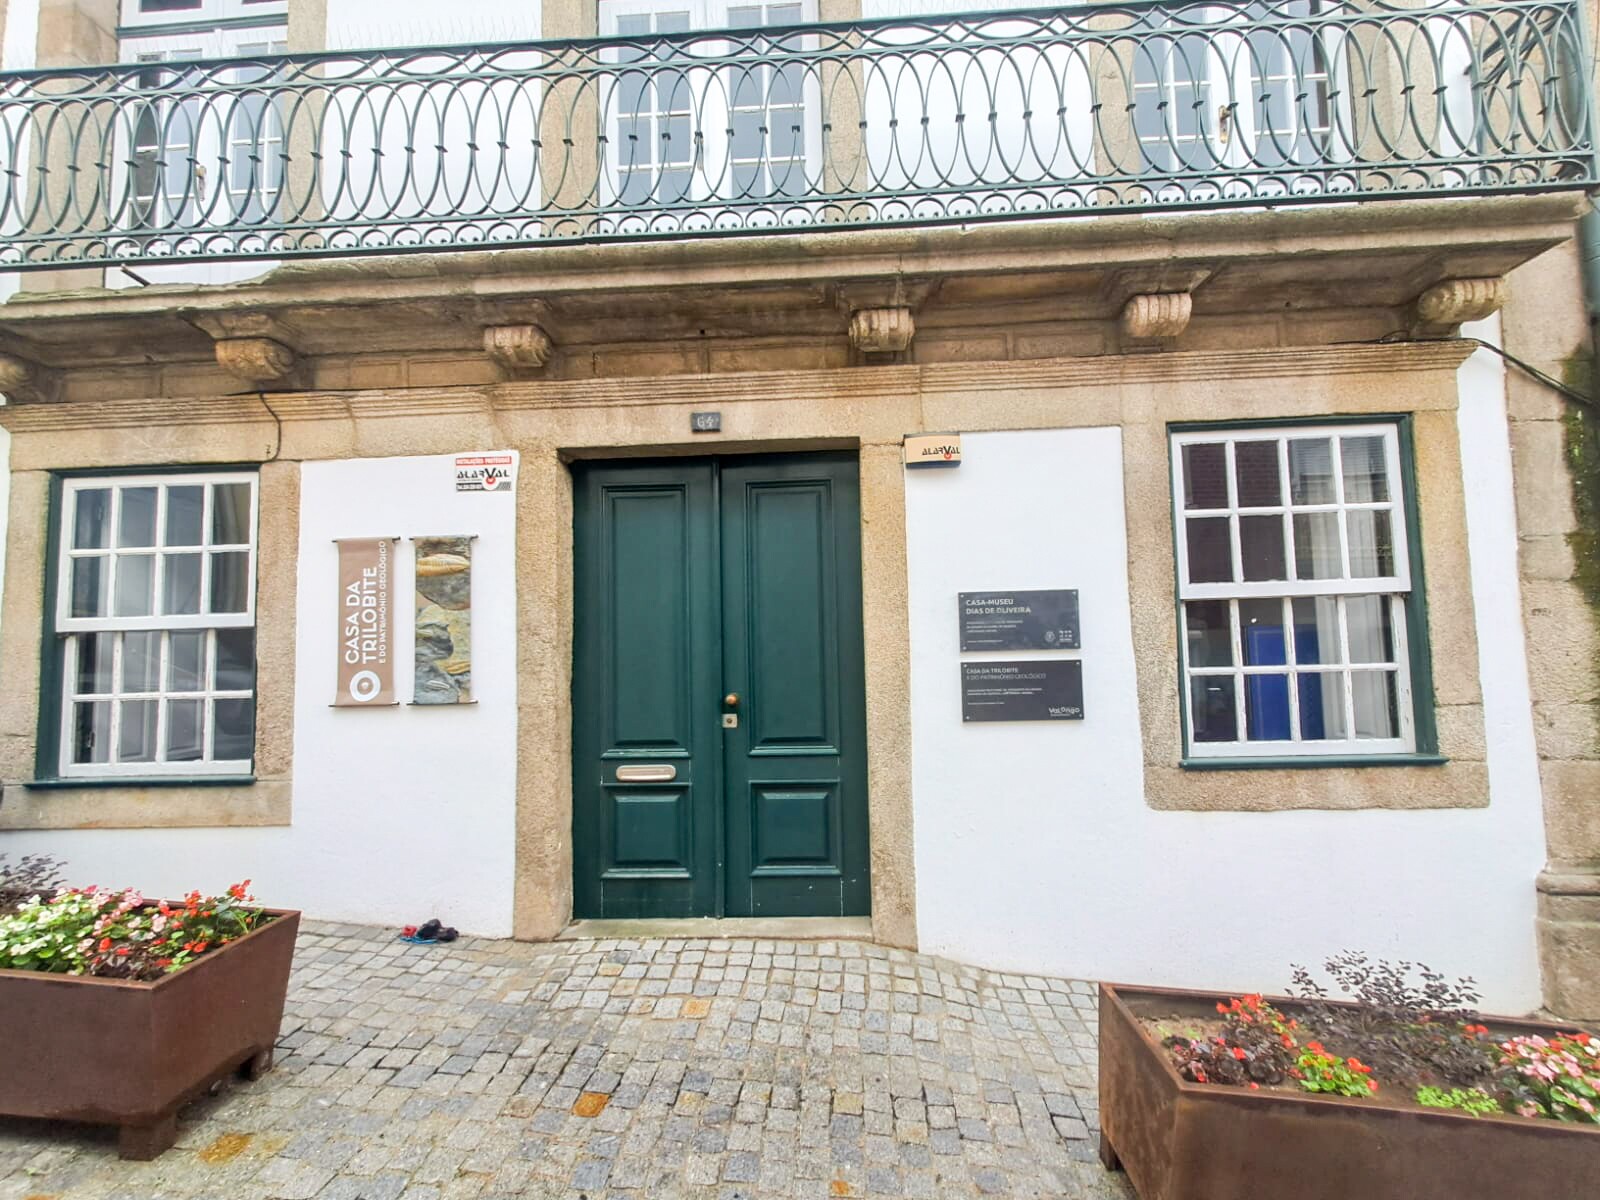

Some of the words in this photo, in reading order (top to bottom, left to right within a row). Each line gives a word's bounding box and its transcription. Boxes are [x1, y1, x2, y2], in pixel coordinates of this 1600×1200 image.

[697, 415, 714, 429] 64
[345, 580, 361, 607] DA
[361, 566, 377, 664] TRILOBITE
[966, 607, 984, 615] DIAS
[996, 606, 1032, 614] OLIVEIRA
[345, 611, 360, 664] CASA
[379, 644, 387, 657] DO
